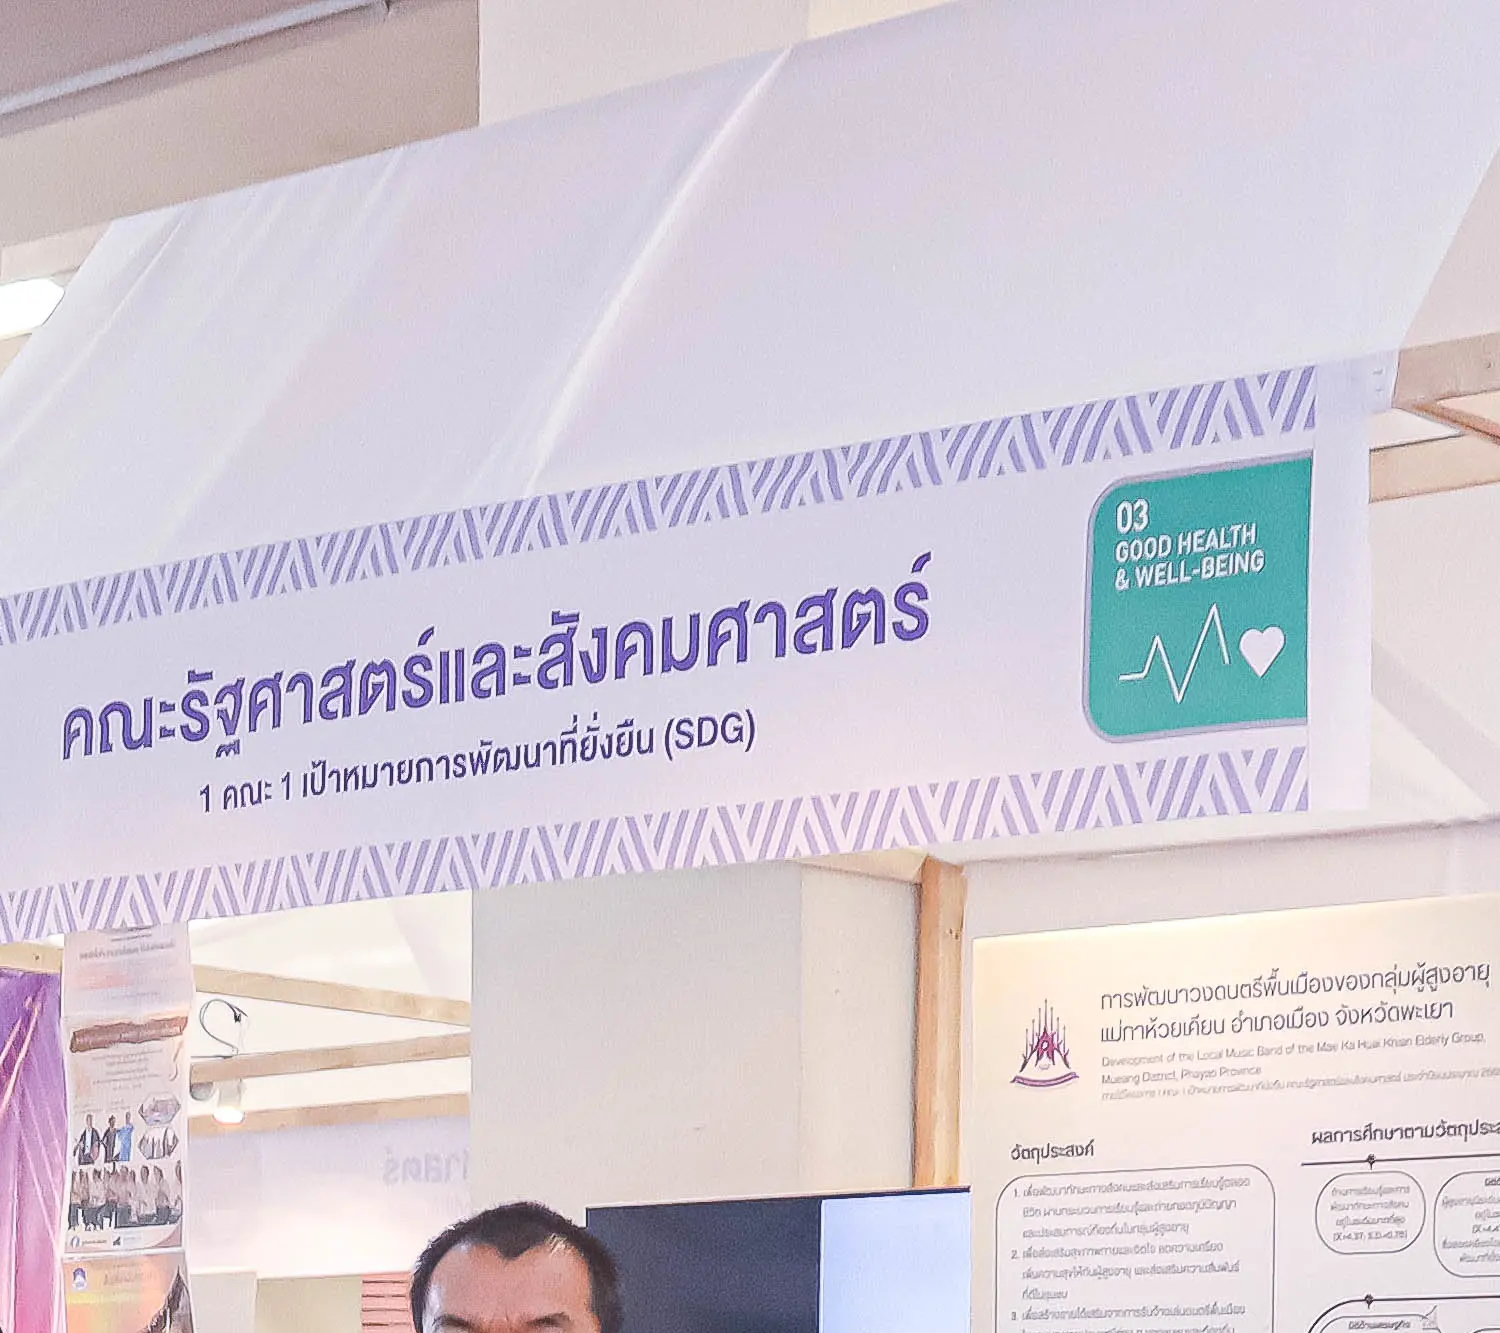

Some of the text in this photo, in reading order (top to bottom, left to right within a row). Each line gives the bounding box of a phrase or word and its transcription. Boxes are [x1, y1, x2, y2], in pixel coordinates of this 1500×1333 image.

[1115, 497, 1150, 535] 03
[1114, 522, 1258, 564] GOOD HEALTH
[1114, 548, 1266, 592] & WELL-BEING
[62, 551, 932, 761] คณะรัฐศาสตร์และสังคมศาสตร์
[199, 708, 757, 814] 1 คณะ 1 เป้าหมายการพัฒนาที่ยั่งยืน (SDG)
[1100, 961, 1492, 1011] การพัฒนาวงดนตรีพื้นเมืองของกลุ่มผู้สูงอายุ
[1100, 1000, 1455, 1043] แม่กาห้วยเคียน อำเภอเมือง จังหวัดพะเยา
[1009, 1138, 1096, 1166] วัตถุประสงค์
